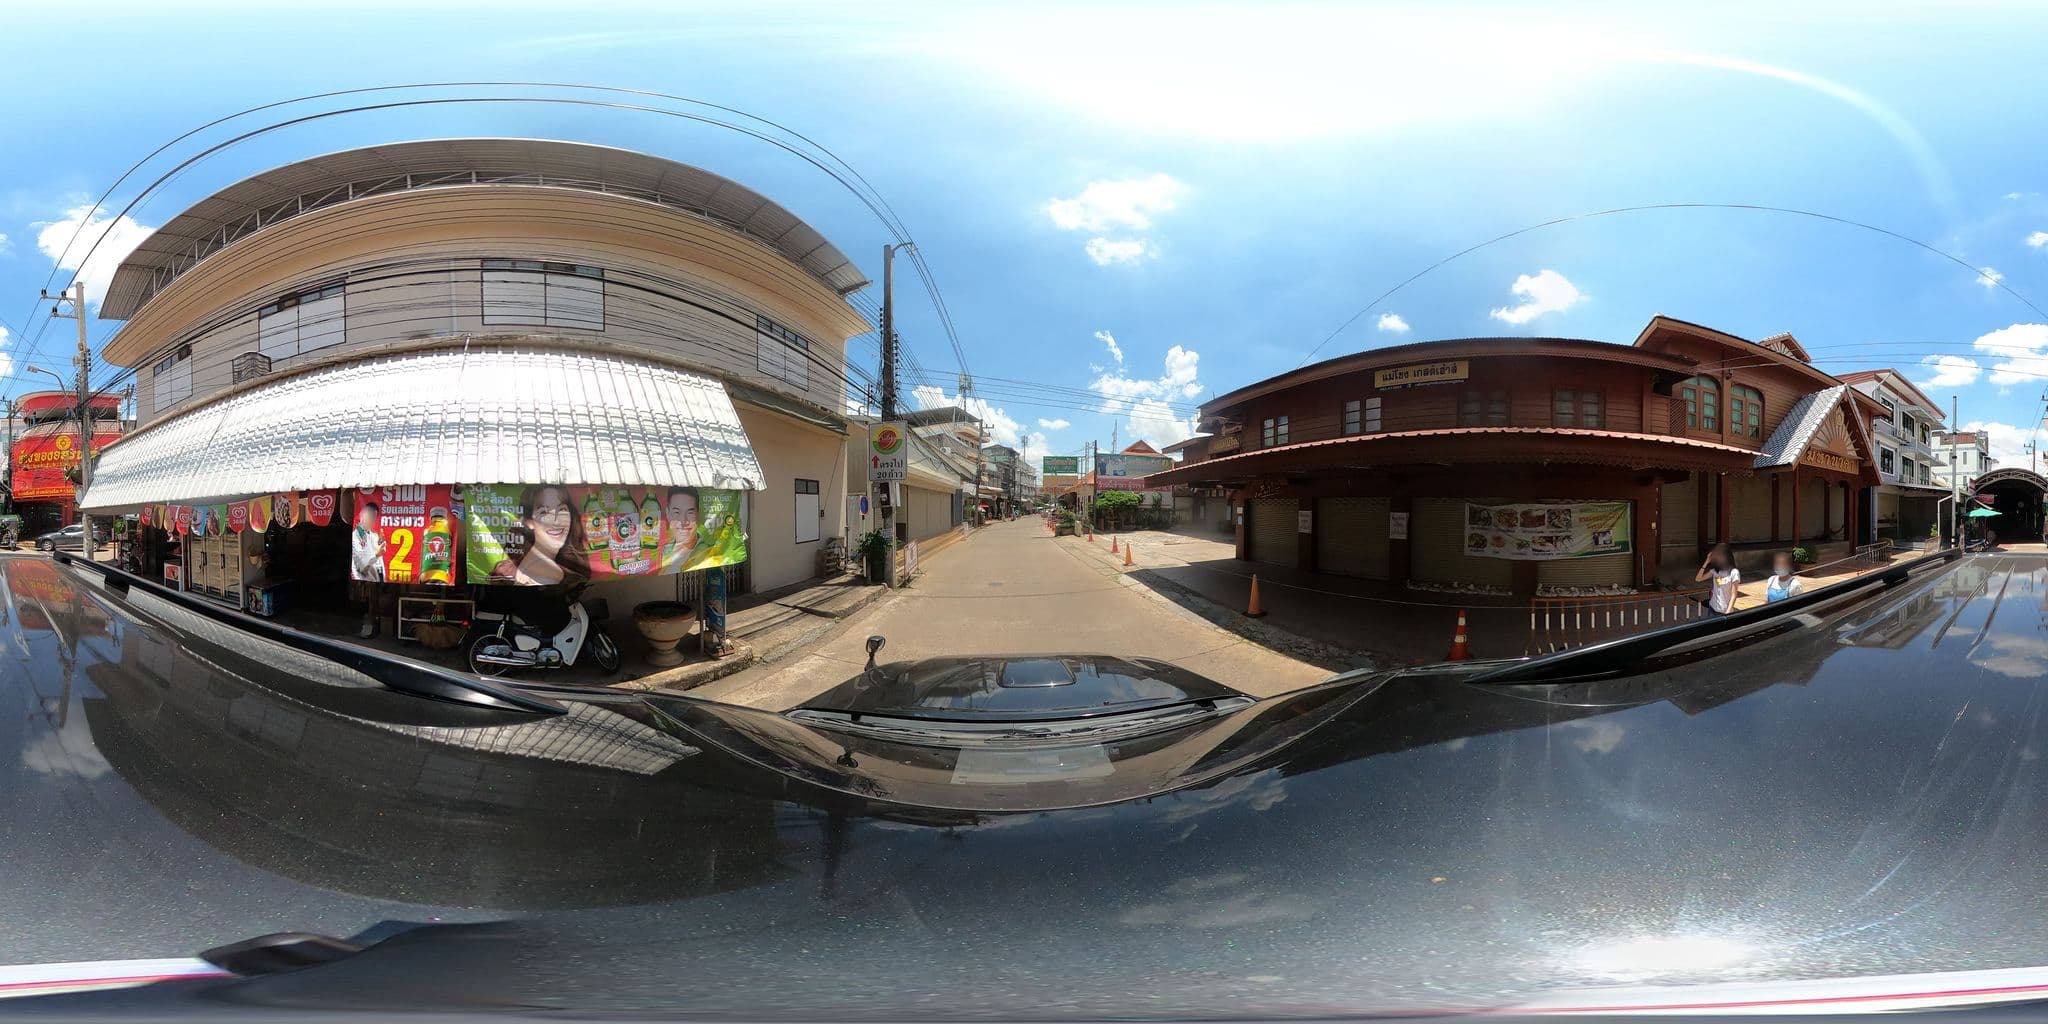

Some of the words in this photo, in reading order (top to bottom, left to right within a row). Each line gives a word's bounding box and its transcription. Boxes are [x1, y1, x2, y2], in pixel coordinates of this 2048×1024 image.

[880, 458, 904, 468] ตรงไป
[381, 516, 425, 527] คาราบาว
[390, 529, 414, 570] 2
